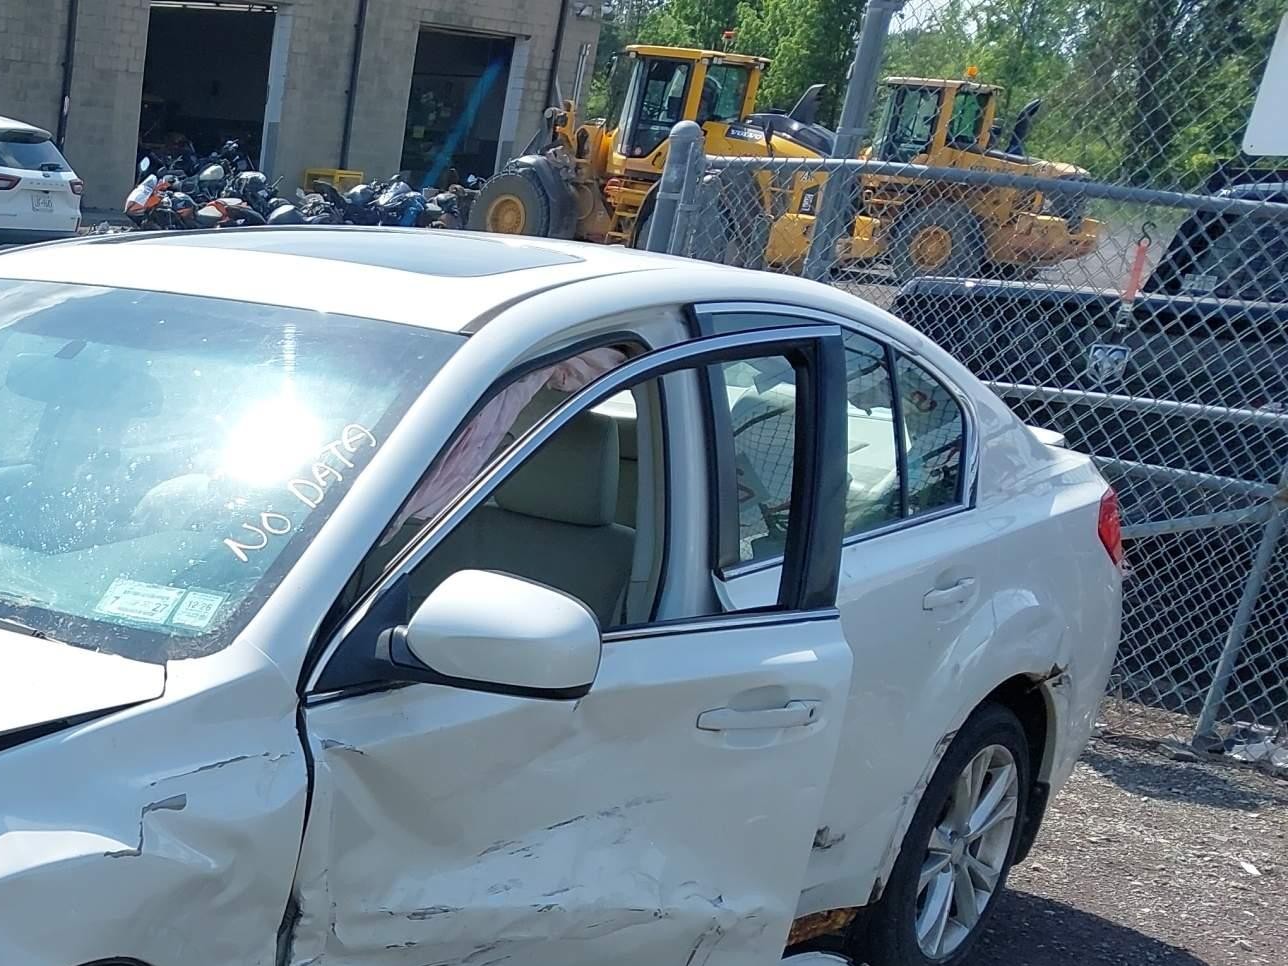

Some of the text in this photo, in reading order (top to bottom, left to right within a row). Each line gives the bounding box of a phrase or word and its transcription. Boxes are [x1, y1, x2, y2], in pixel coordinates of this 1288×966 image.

[223, 423, 377, 562] NO DATA
[151, 602, 169, 613] 27
